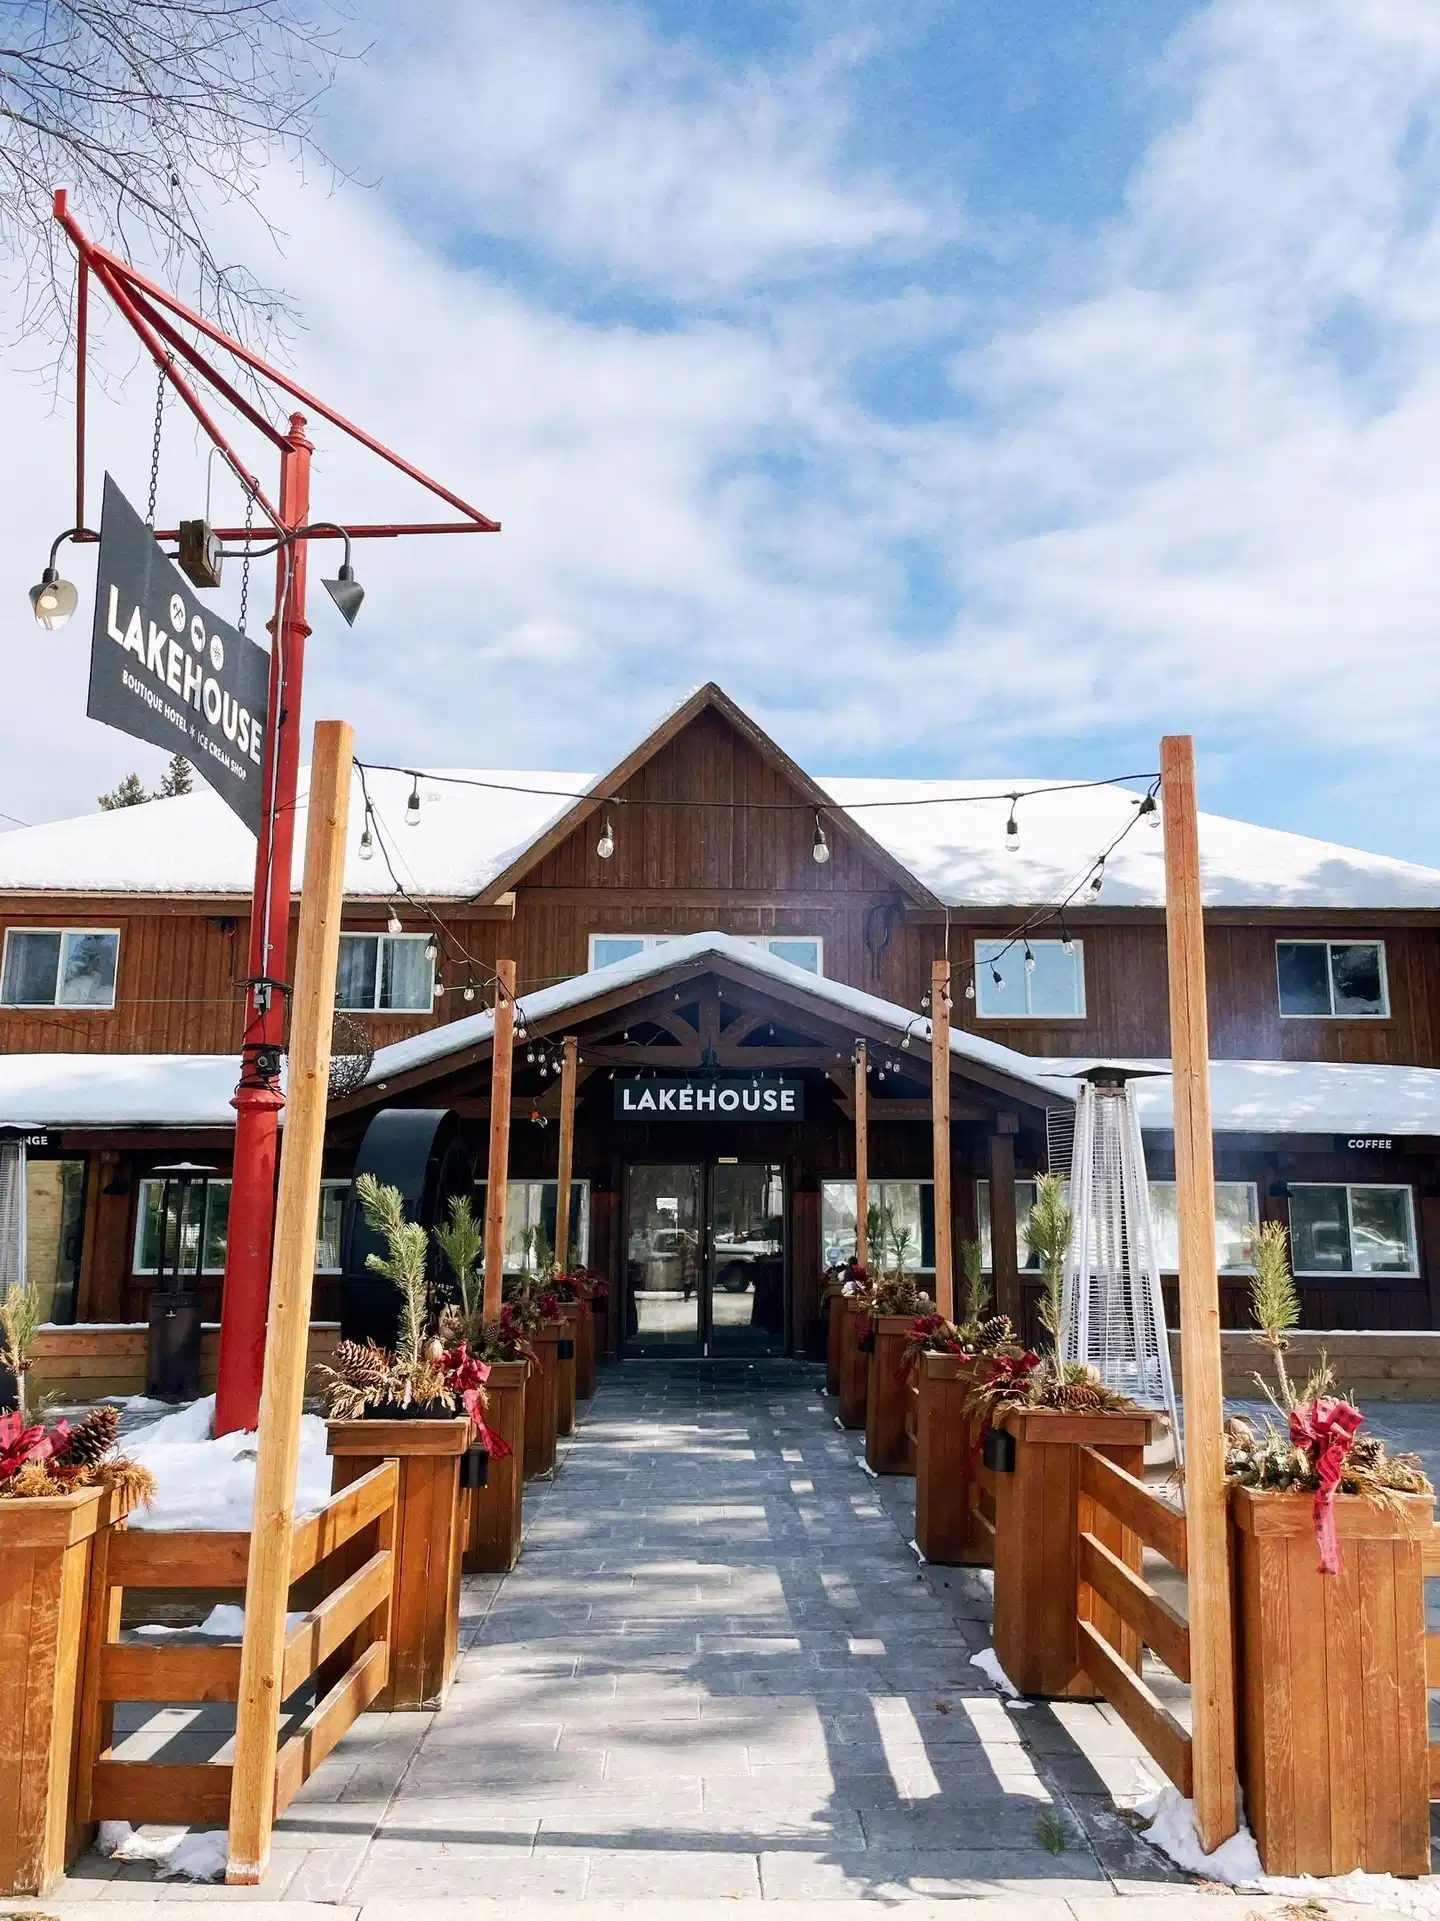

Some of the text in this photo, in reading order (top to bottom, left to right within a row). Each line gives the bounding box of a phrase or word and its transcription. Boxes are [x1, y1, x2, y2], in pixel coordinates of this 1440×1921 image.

[107, 584, 263, 766] LAKEHOUSE
[122, 669, 247, 781] BOUTIQUE HOTEL ICE CREAM SHOP
[623, 1088, 796, 1112] LAKEHOUSE
[26, 1135, 48, 1146] NGE
[1347, 1139, 1392, 1149] COFFEE
